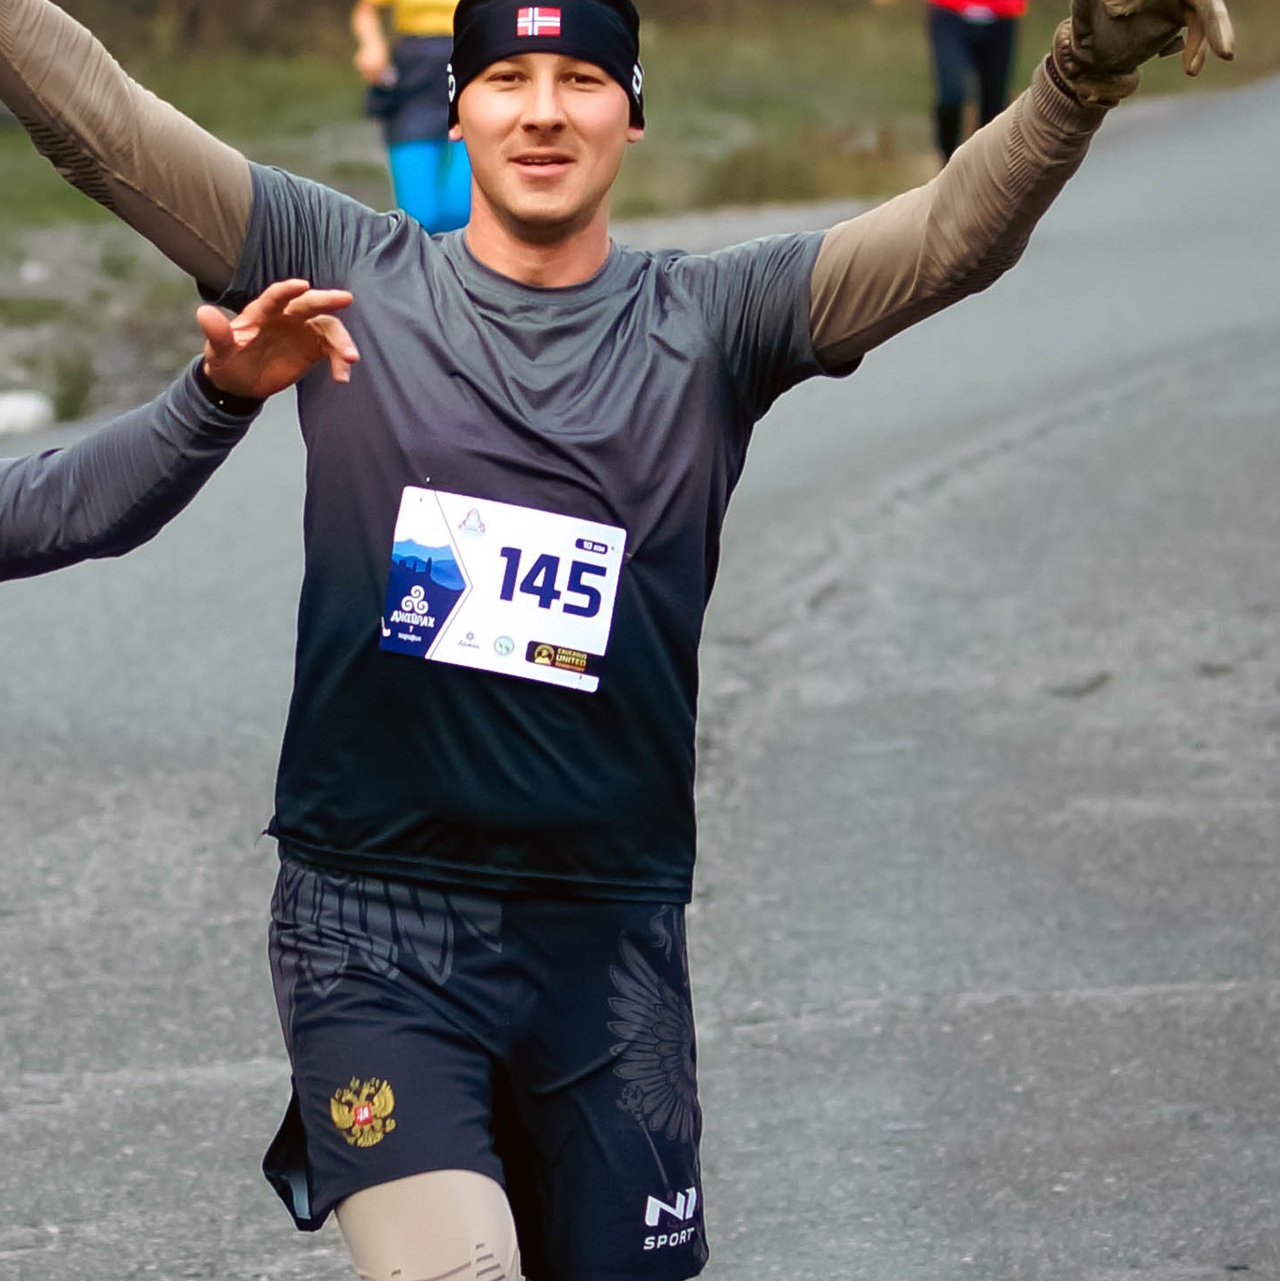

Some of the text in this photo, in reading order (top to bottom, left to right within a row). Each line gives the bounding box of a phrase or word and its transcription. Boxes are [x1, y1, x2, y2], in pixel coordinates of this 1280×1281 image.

[583, 540, 593, 550] 10
[499, 546, 607, 618] 145
[556, 654, 587, 666] UNITED
[643, 1227, 695, 1251] SPORT
